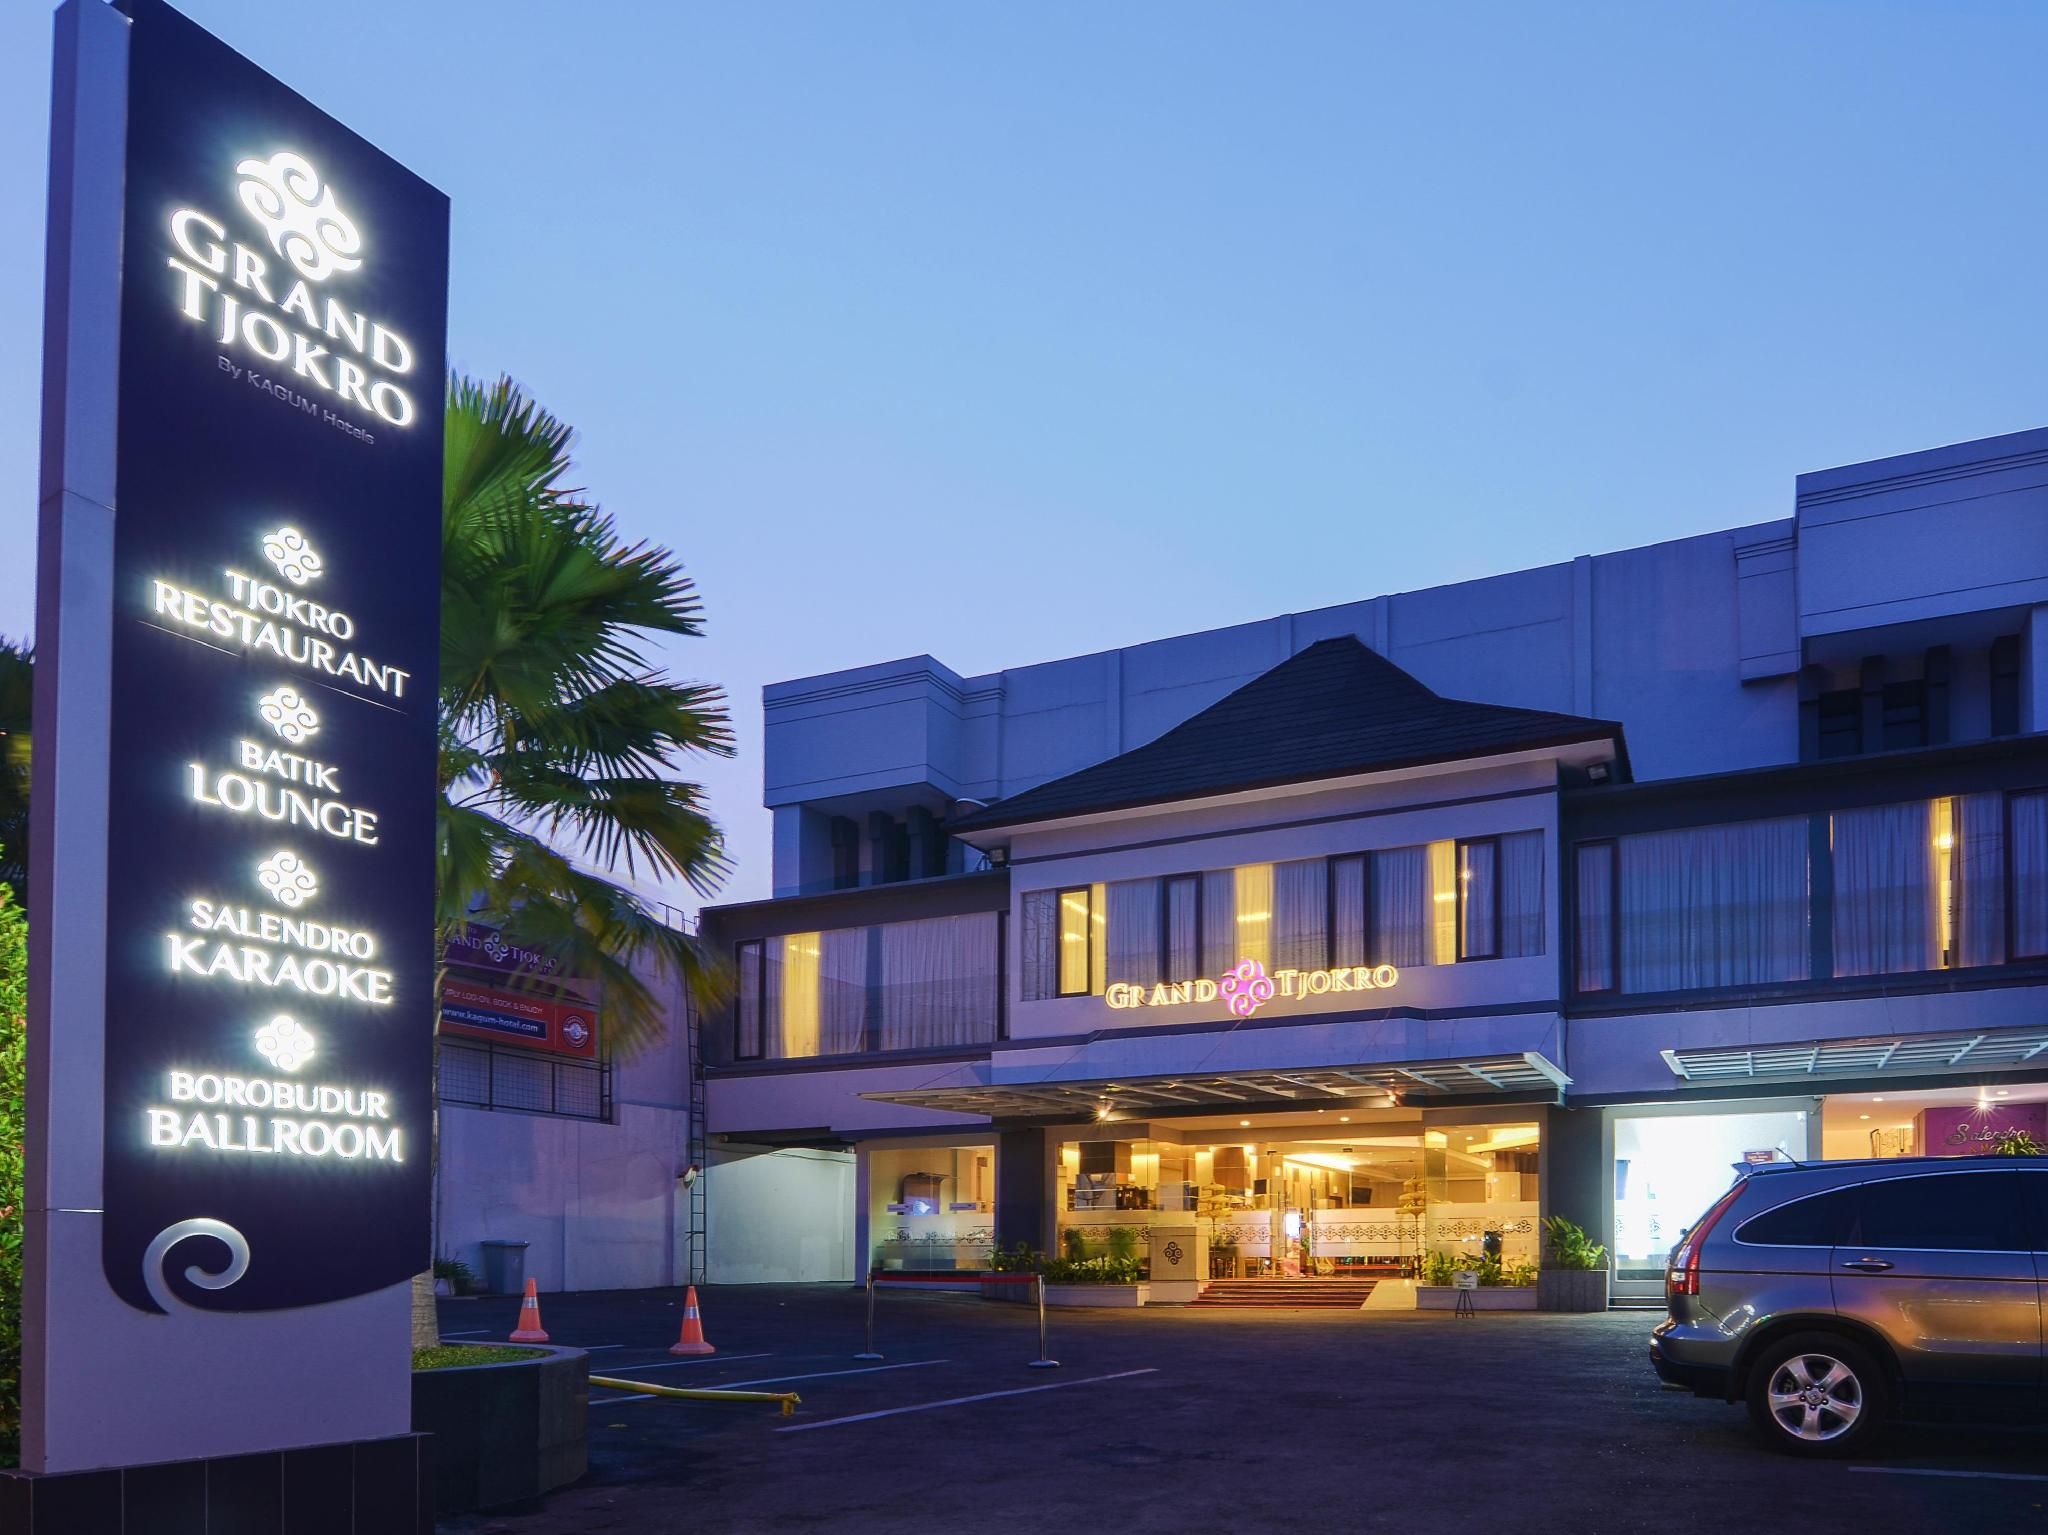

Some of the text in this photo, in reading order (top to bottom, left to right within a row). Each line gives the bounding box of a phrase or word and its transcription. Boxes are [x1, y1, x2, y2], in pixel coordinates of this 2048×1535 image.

[169, 208, 413, 375] GRAND
[167, 256, 414, 428] TJOKRO
[217, 355, 375, 445] By KAGUM Hotels
[153, 579, 410, 698] RESTAURANT
[226, 569, 354, 641] TJOKRO
[240, 739, 340, 793] BATIK
[190, 763, 379, 846] LOUNGE
[191, 900, 374, 959] SALENDRO
[167, 934, 393, 1005] KARAOKE
[1105, 965, 1400, 1009] GRAND TJOKRO
[170, 1071, 389, 1119] BOROBUDUR
[147, 1108, 404, 1163] BALLROOM
